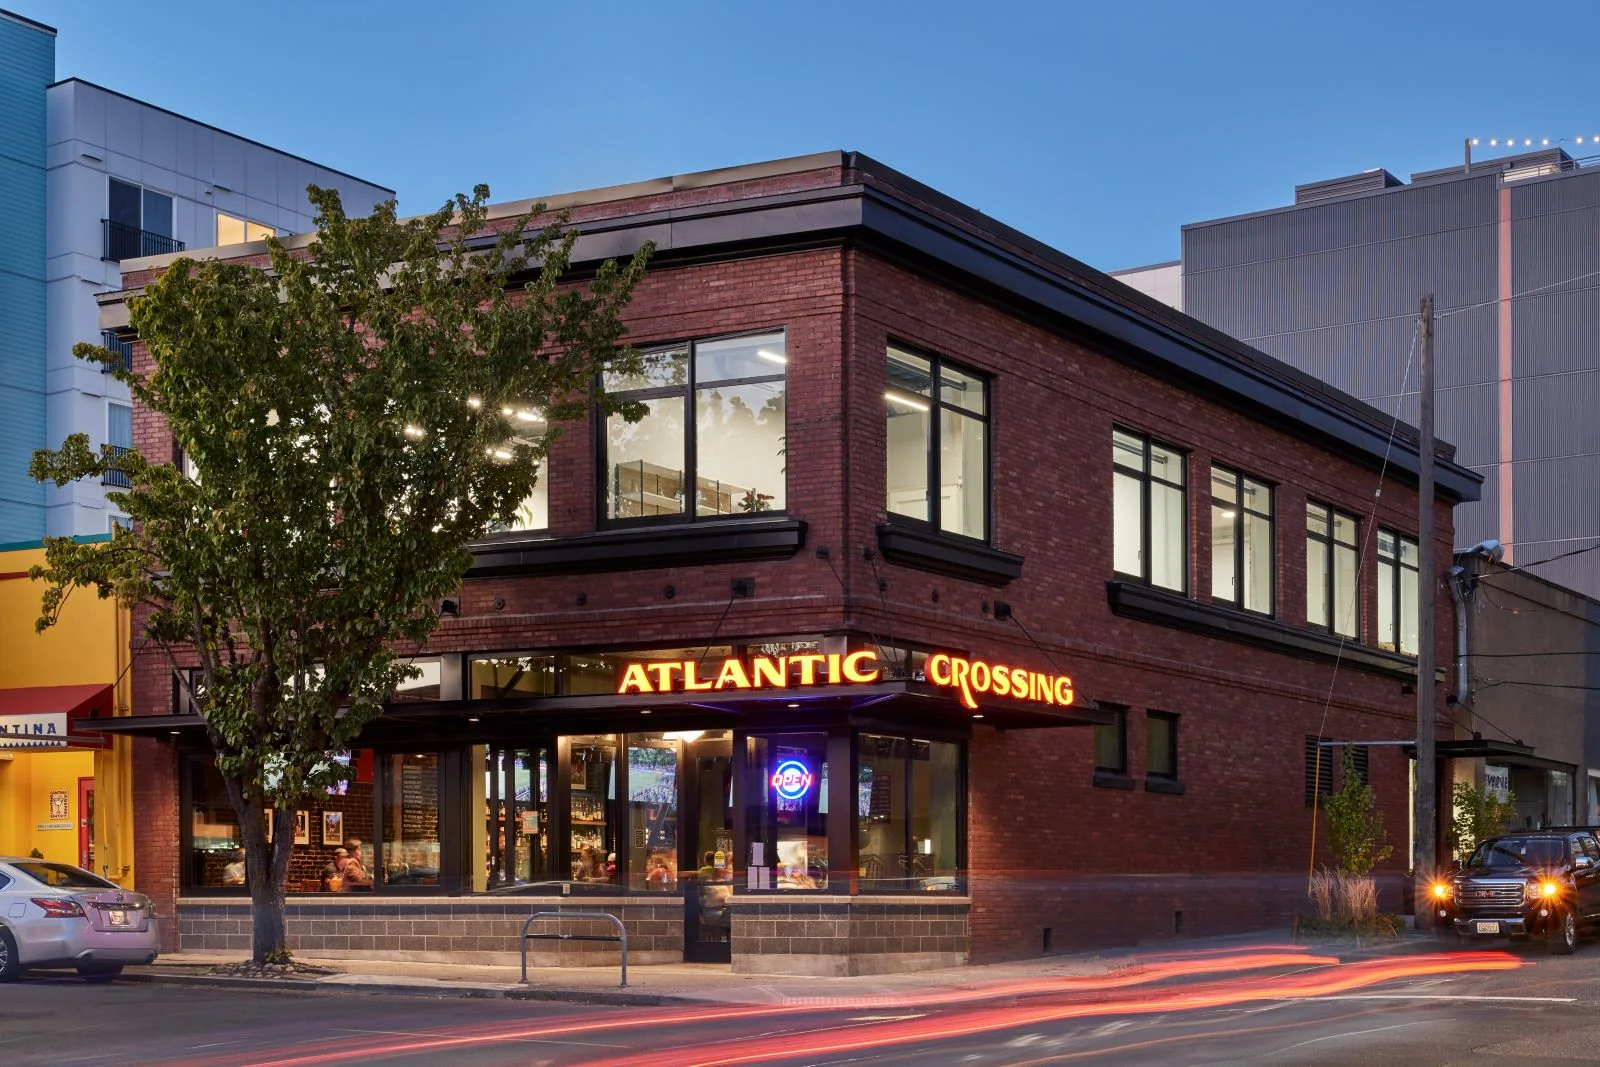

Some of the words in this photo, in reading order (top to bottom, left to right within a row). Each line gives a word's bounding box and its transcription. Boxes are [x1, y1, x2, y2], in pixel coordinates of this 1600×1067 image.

[617, 650, 879, 694] ATLANTIC
[928, 653, 1074, 709] CROSSING
[771, 773, 812, 787] OPEN
